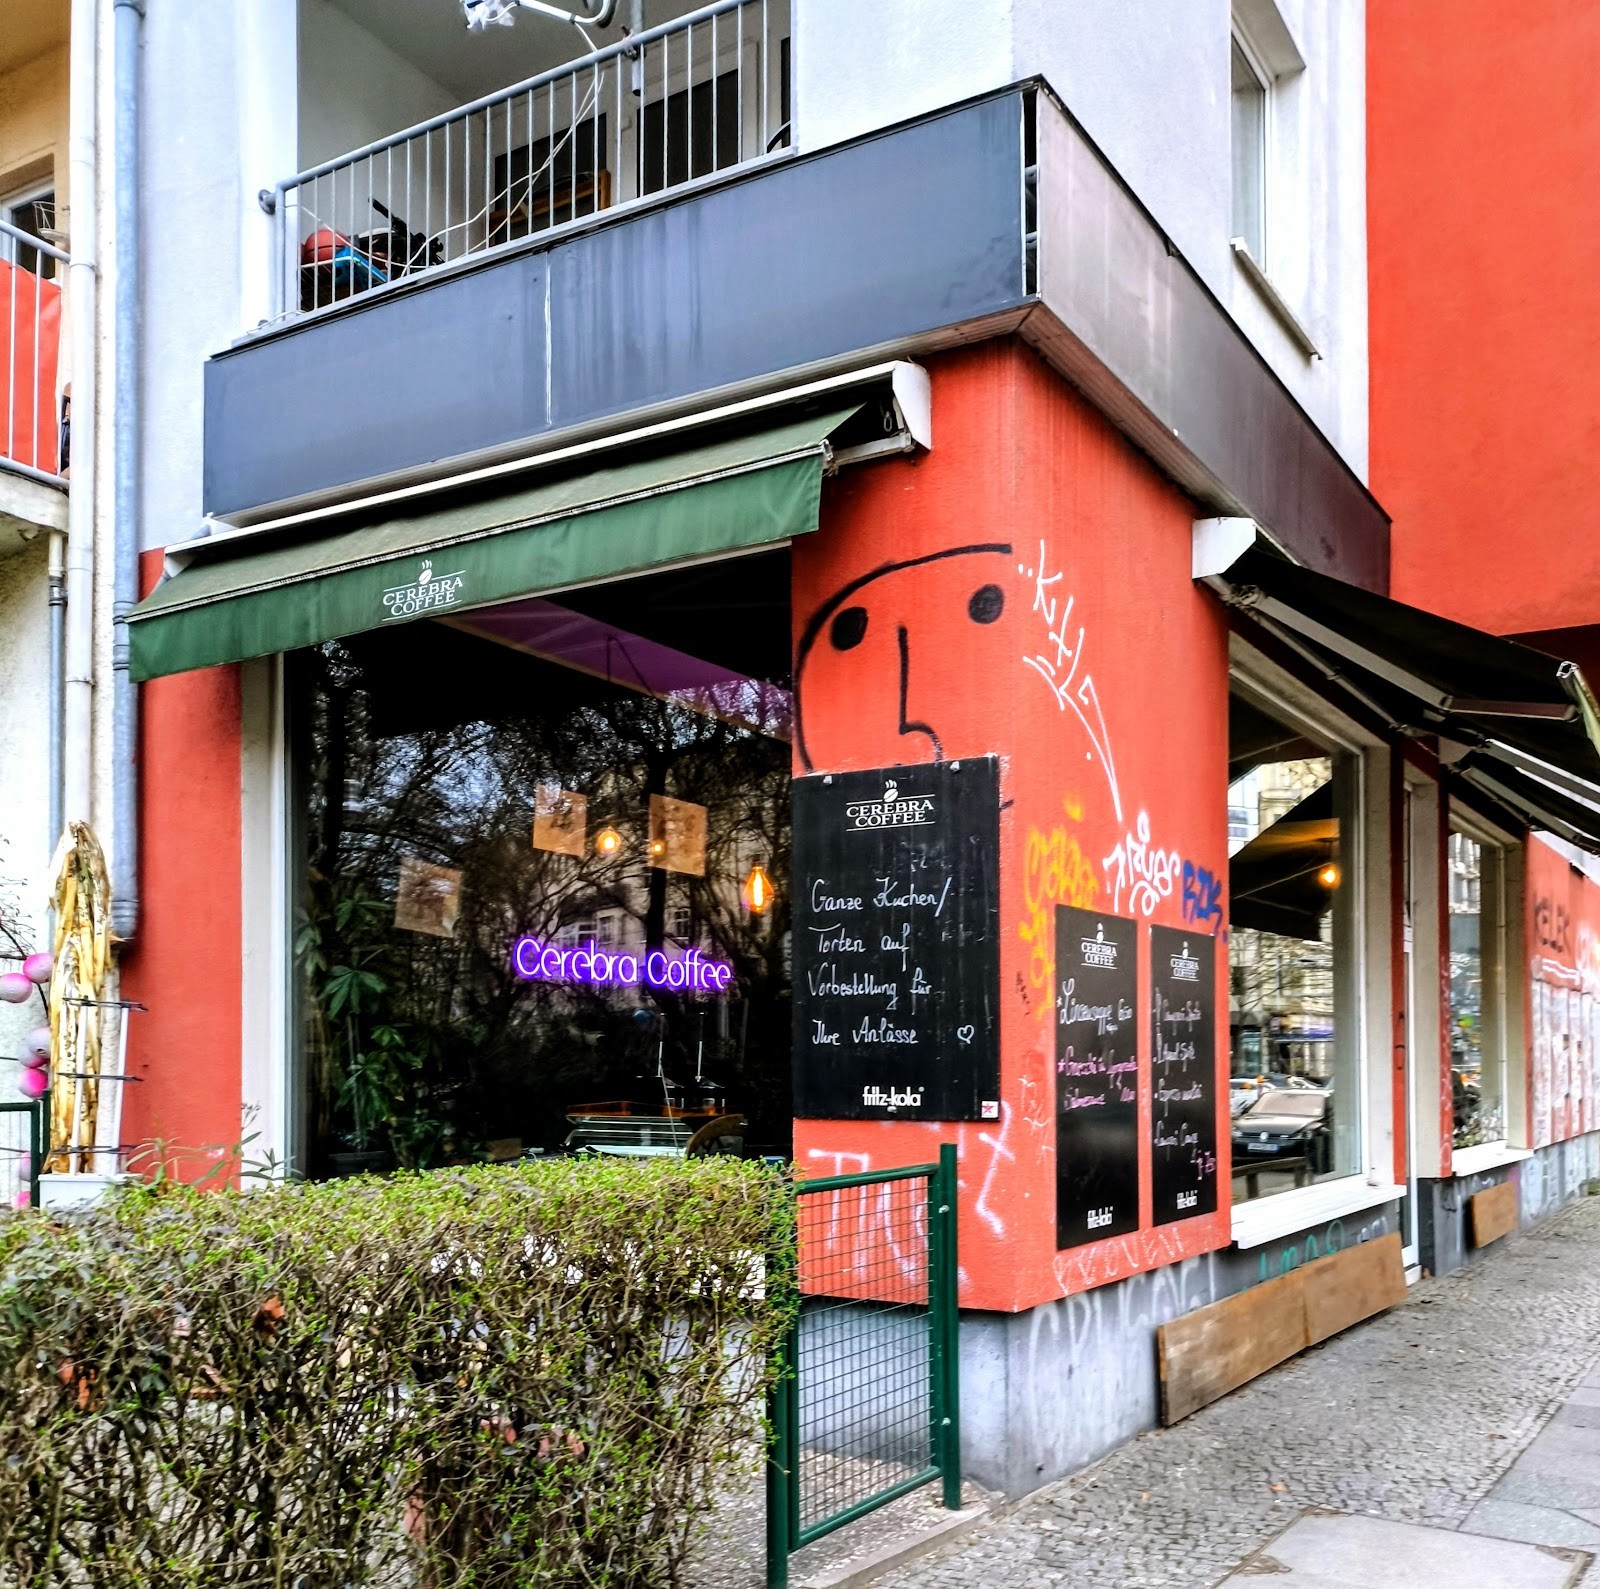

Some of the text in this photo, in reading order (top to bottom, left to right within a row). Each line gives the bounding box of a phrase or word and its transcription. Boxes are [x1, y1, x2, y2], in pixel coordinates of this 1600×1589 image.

[383, 577, 463, 606] CEREBRA
[391, 590, 456, 616] COFFEE
[846, 800, 934, 818] CEREBRA
[855, 811, 927, 828] COFFEE
[811, 878, 864, 913] Ganze
[808, 922, 911, 972] Torten auf
[516, 938, 732, 989] Cerebra Coffee
[807, 962, 899, 1010] Vorbestellung
[812, 1018, 841, 1046] Ihre
